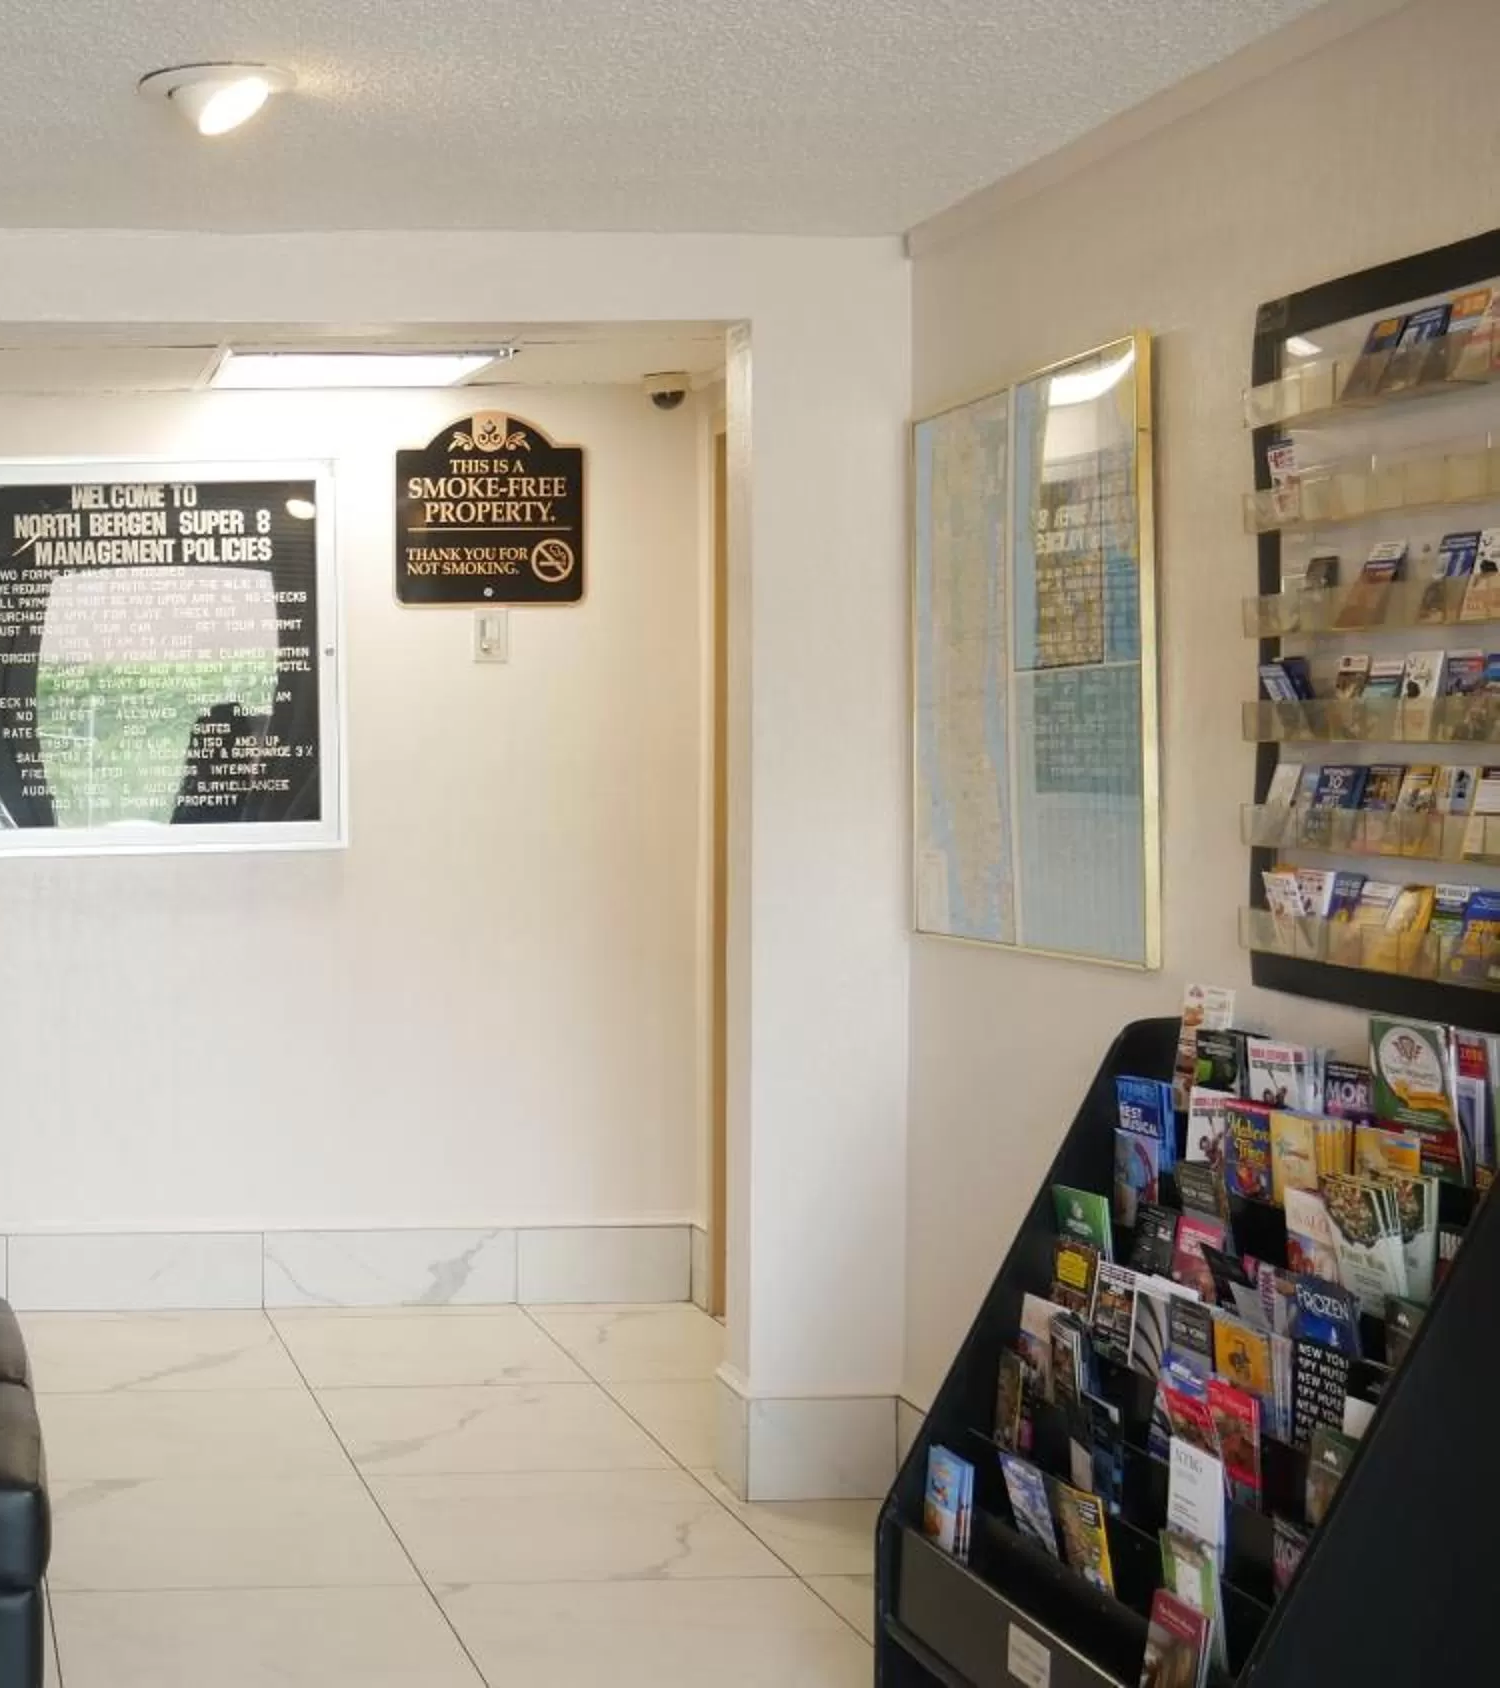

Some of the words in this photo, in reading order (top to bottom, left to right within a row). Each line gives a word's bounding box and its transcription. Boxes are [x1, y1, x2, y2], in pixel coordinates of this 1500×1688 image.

[450, 459, 489, 474] THIS
[493, 459, 508, 473] IS
[513, 459, 524, 473] A
[407, 477, 567, 499] SMOKE-FREE
[71, 484, 165, 509] WELCOME
[172, 484, 197, 507] TO
[424, 501, 556, 523] PROPERTY.
[14, 513, 81, 539] NORTH
[90, 512, 166, 536] BERGEN
[179, 510, 244, 535] SUPER
[257, 510, 270, 533] 8
[34, 539, 175, 566] MANAGEMENT
[182, 537, 273, 563] POLICIES
[406, 548, 460, 561] THANK
[464, 548, 497, 561] YOU
[499, 547, 528, 560] FOR
[407, 563, 441, 576] NOT
[442, 562, 520, 576] SMOKING.
[263, 591, 307, 603] CHECKS
[274, 660, 311, 671] MOTEL
[275, 692, 292, 703] AM
[16, 711, 32, 721] NO
[233, 705, 274, 717] ROOMS
[194, 723, 231, 734] SUITES
[265, 735, 280, 746] UP
[211, 763, 267, 775] INTERNET
[176, 794, 238, 806] PROPERTY
[1296, 1283, 1350, 1321] FROZEN
[1298, 1343, 1323, 1360] NEW
[1297, 1371, 1321, 1388] NEW
